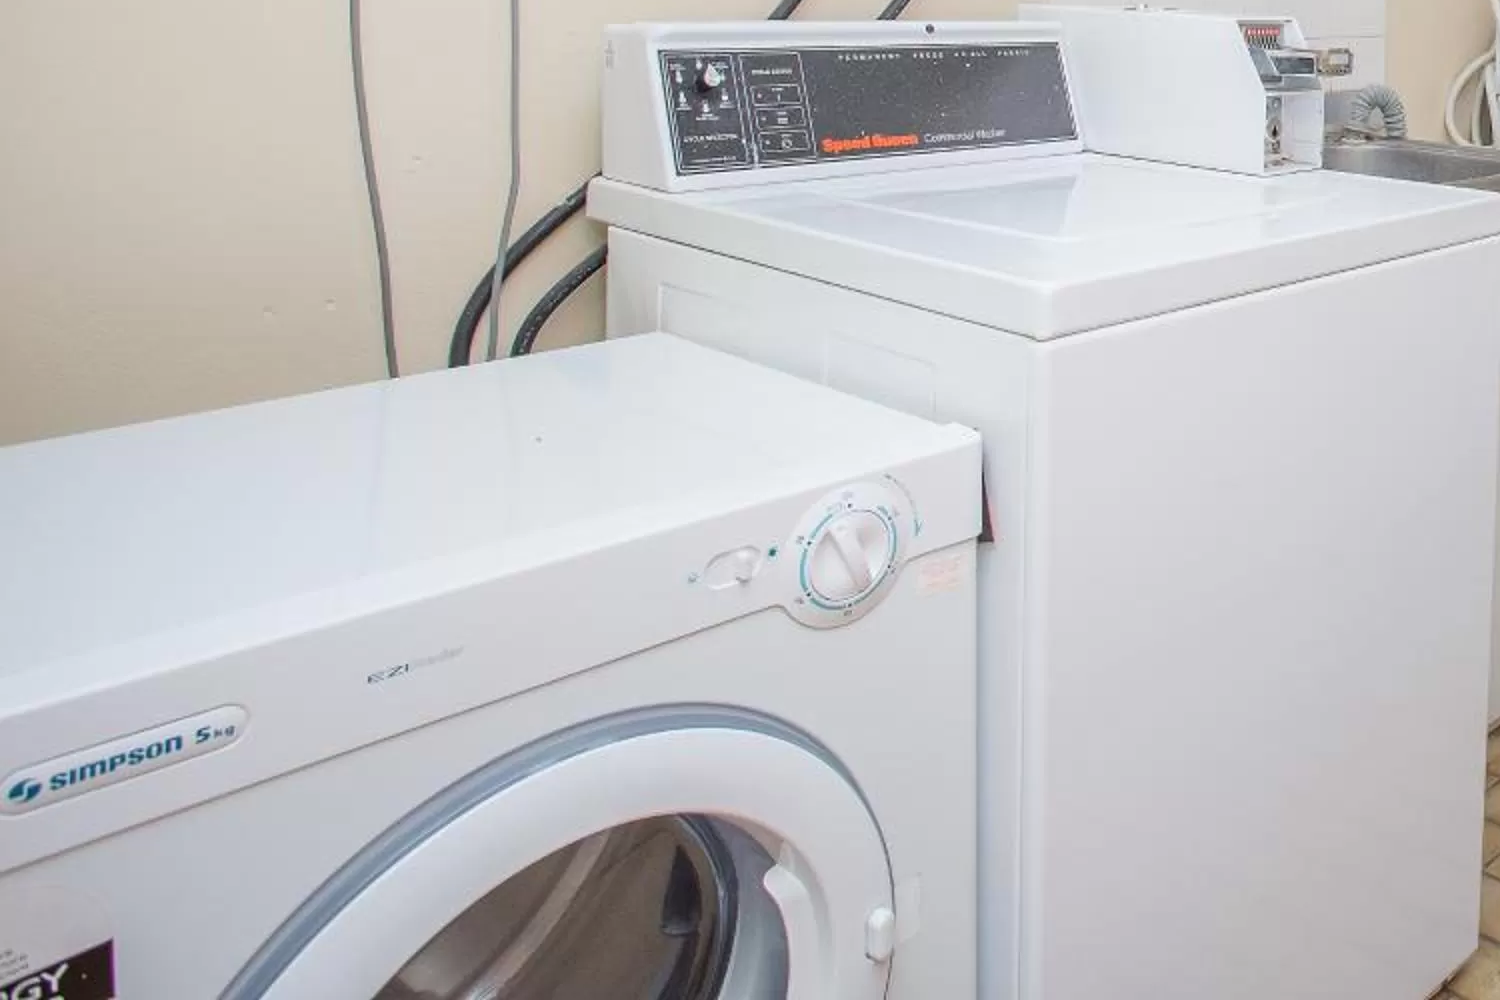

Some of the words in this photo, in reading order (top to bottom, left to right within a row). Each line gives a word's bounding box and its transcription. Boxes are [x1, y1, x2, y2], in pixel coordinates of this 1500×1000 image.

[822, 134, 871, 154] Speed
[872, 132, 921, 150] Queen
[49, 734, 183, 791] SIMPSON
[0, 962, 69, 1000] GY
